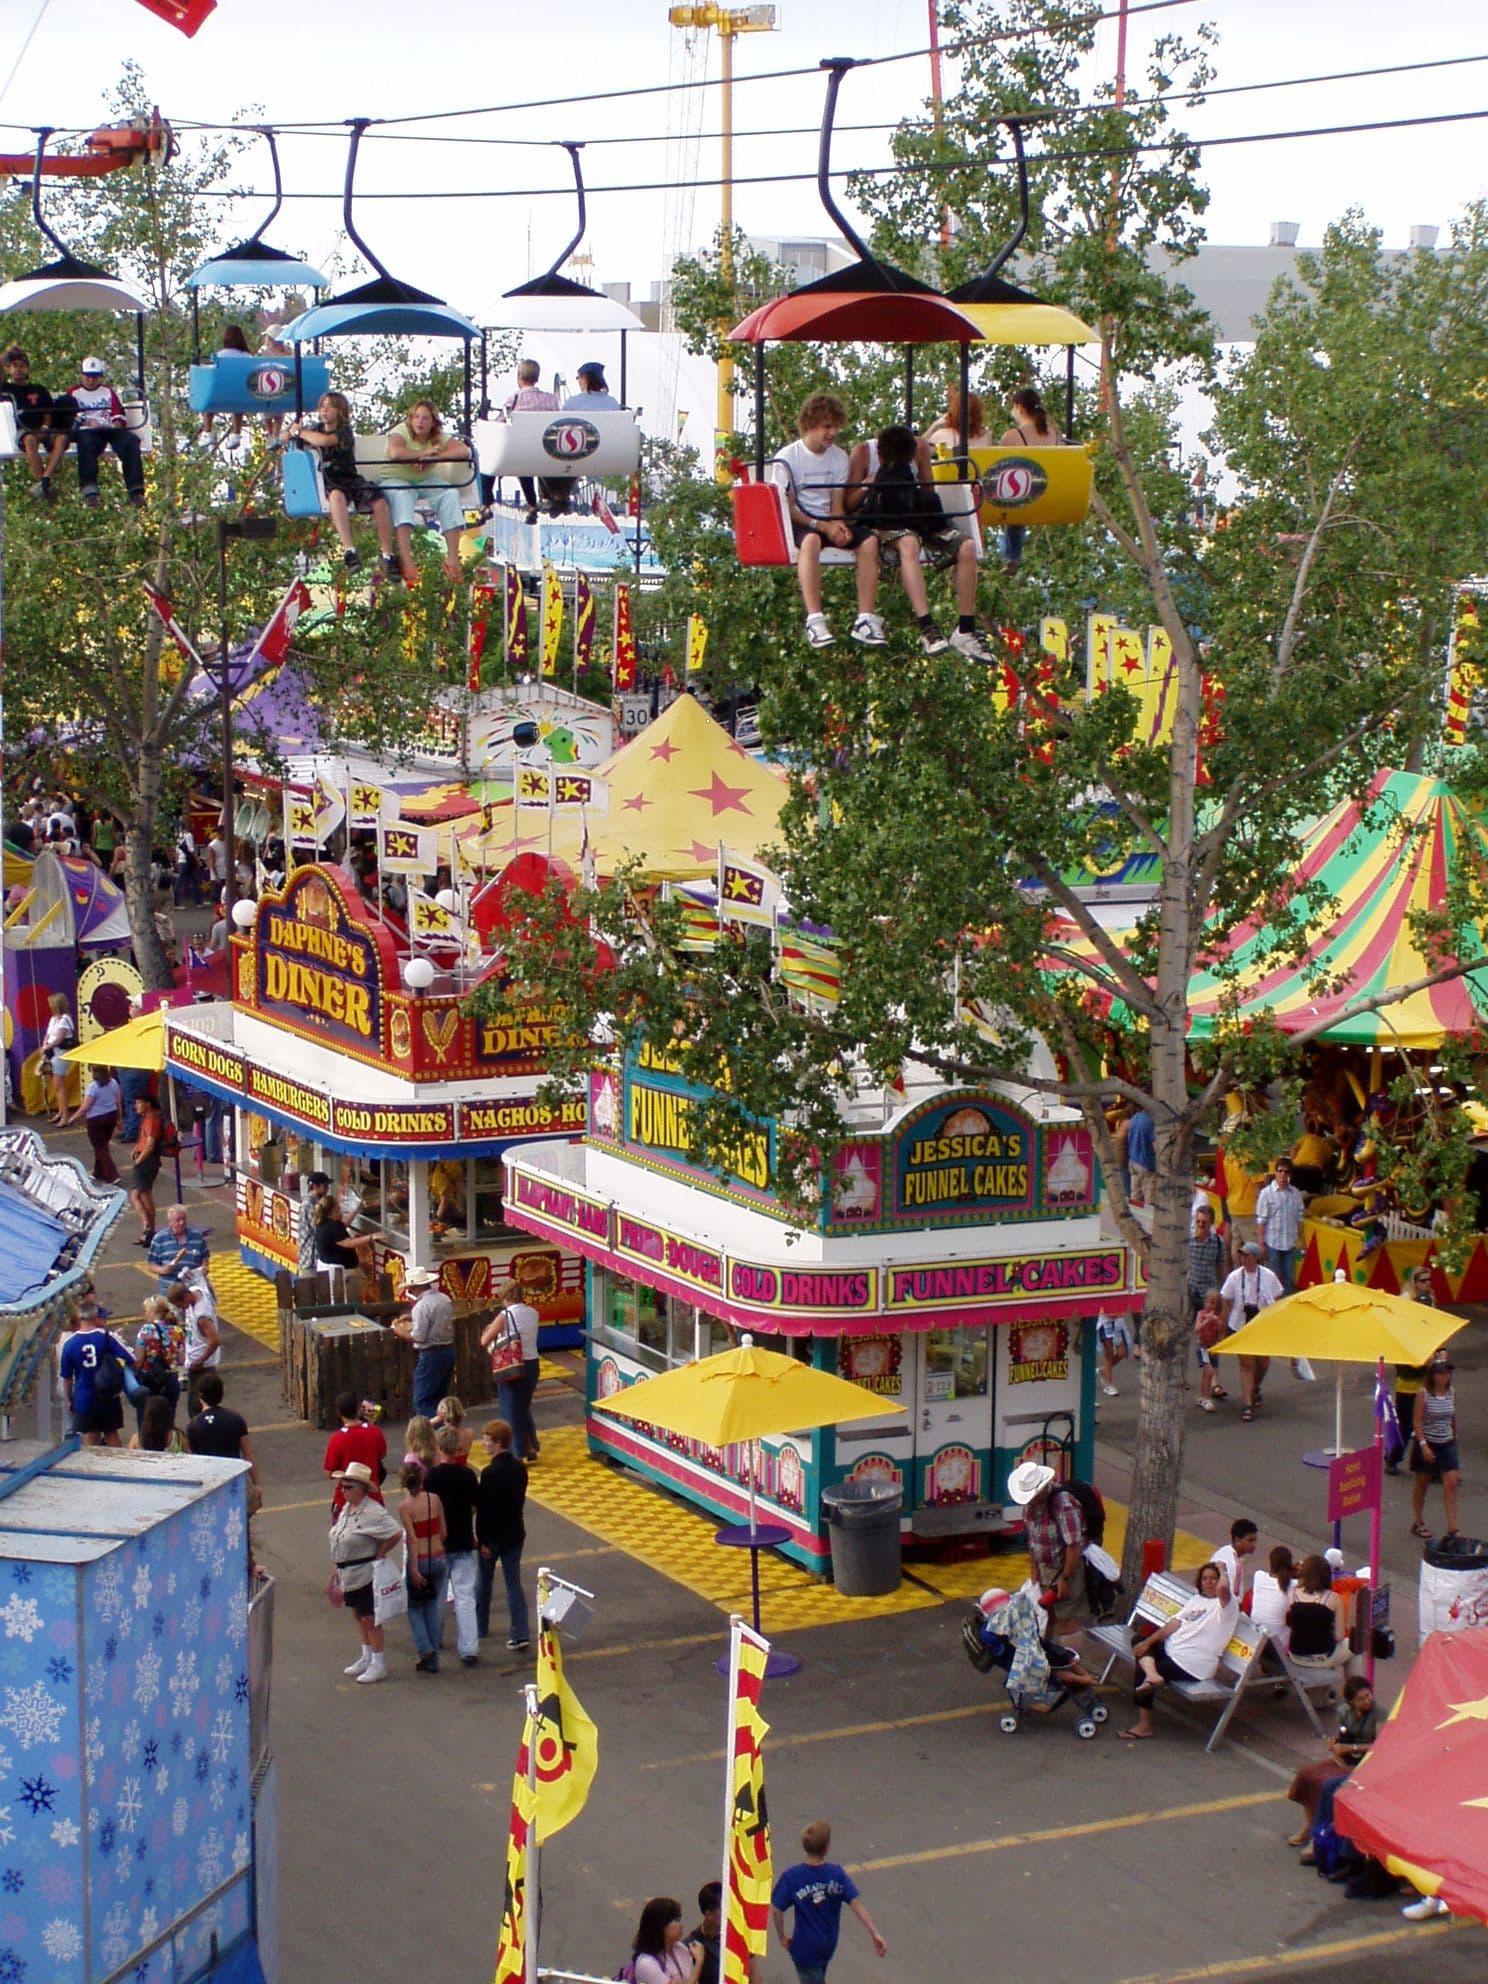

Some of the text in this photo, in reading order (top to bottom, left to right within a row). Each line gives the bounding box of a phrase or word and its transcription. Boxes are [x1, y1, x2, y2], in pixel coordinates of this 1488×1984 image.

[626, 709, 648, 725] 30
[270, 916, 367, 977] DAPHNE'S
[265, 951, 373, 1037] DINER
[208, 1048, 244, 1084] DOGS
[252, 1069, 330, 1123] HAMBURGERS
[631, 1084, 696, 1150] FUNNE
[336, 1106, 448, 1133] COLD DRINKS
[470, 1104, 553, 1131] NACHOS
[909, 1134, 1022, 1166] JESSICA'S
[903, 1164, 1028, 1206] FUNNEL CAKES
[731, 1262, 870, 1307] COLD DRINKS
[892, 1263, 1014, 1304] FUNNEL
[1020, 1253, 1122, 1291] CAKES
[82, 1343, 97, 1368] 3
